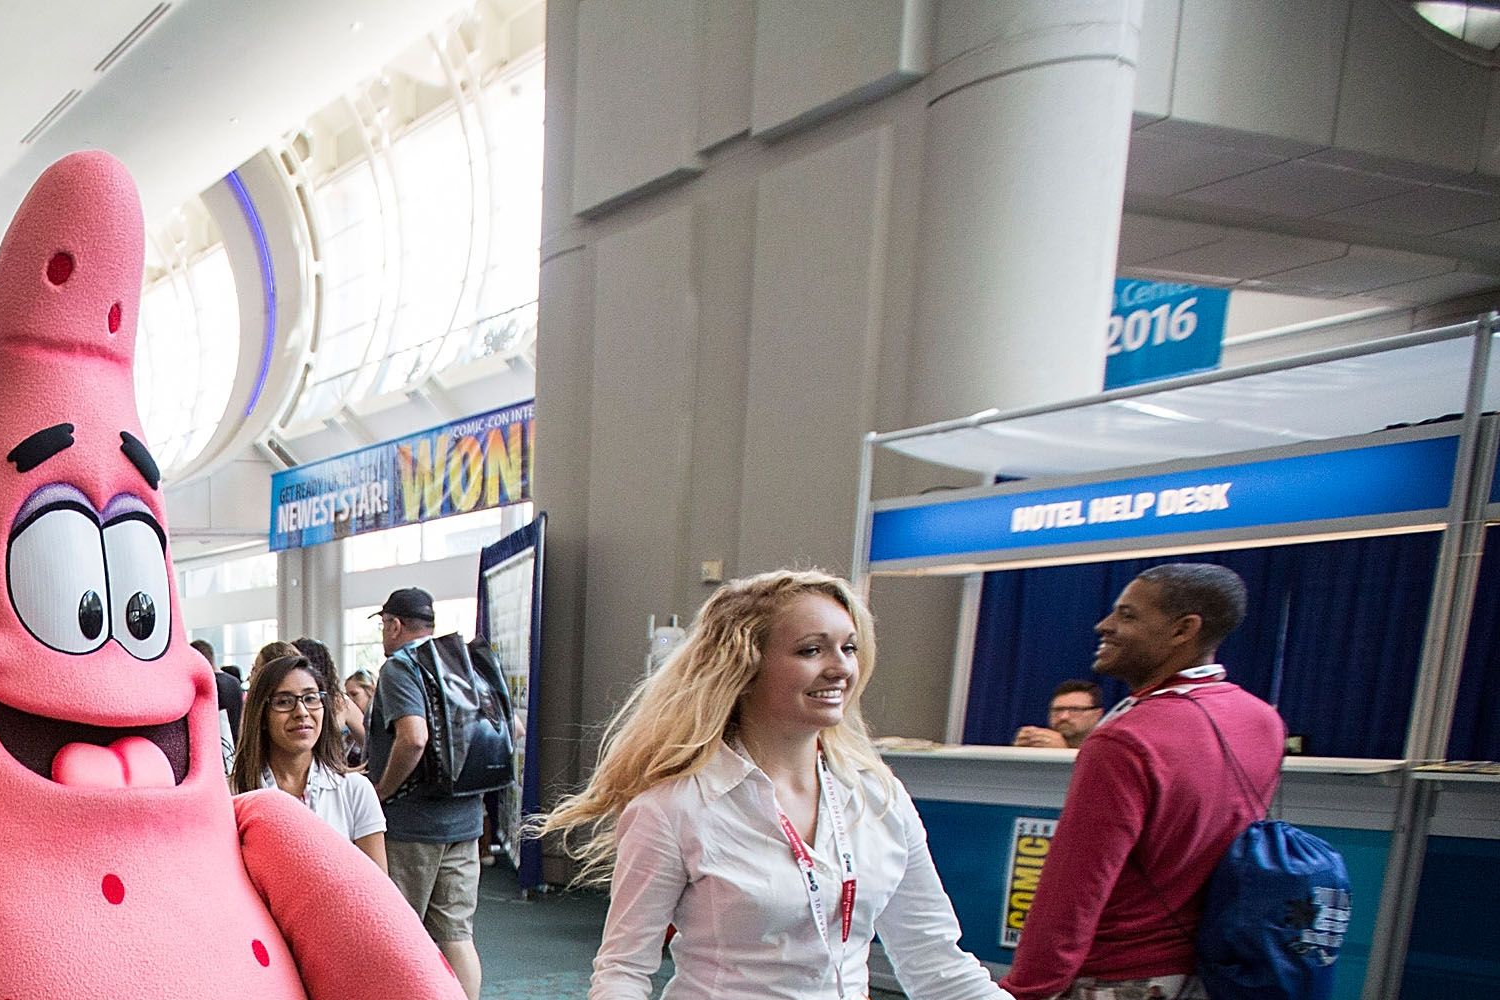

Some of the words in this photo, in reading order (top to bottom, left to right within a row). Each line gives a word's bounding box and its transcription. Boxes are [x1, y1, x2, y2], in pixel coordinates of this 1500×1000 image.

[1106, 297, 1198, 356] 2016
[453, 411, 510, 438] COMIC-CON
[277, 492, 338, 534] NEWEST
[339, 479, 389, 521] STAR!
[280, 484, 296, 504] GET
[295, 477, 324, 500] READY
[1011, 500, 1086, 533] HOTEL
[1088, 492, 1156, 524] HELP
[1156, 482, 1233, 517] DESK
[1018, 822, 1051, 835] SAN
[1008, 836, 1051, 929] COMIC
